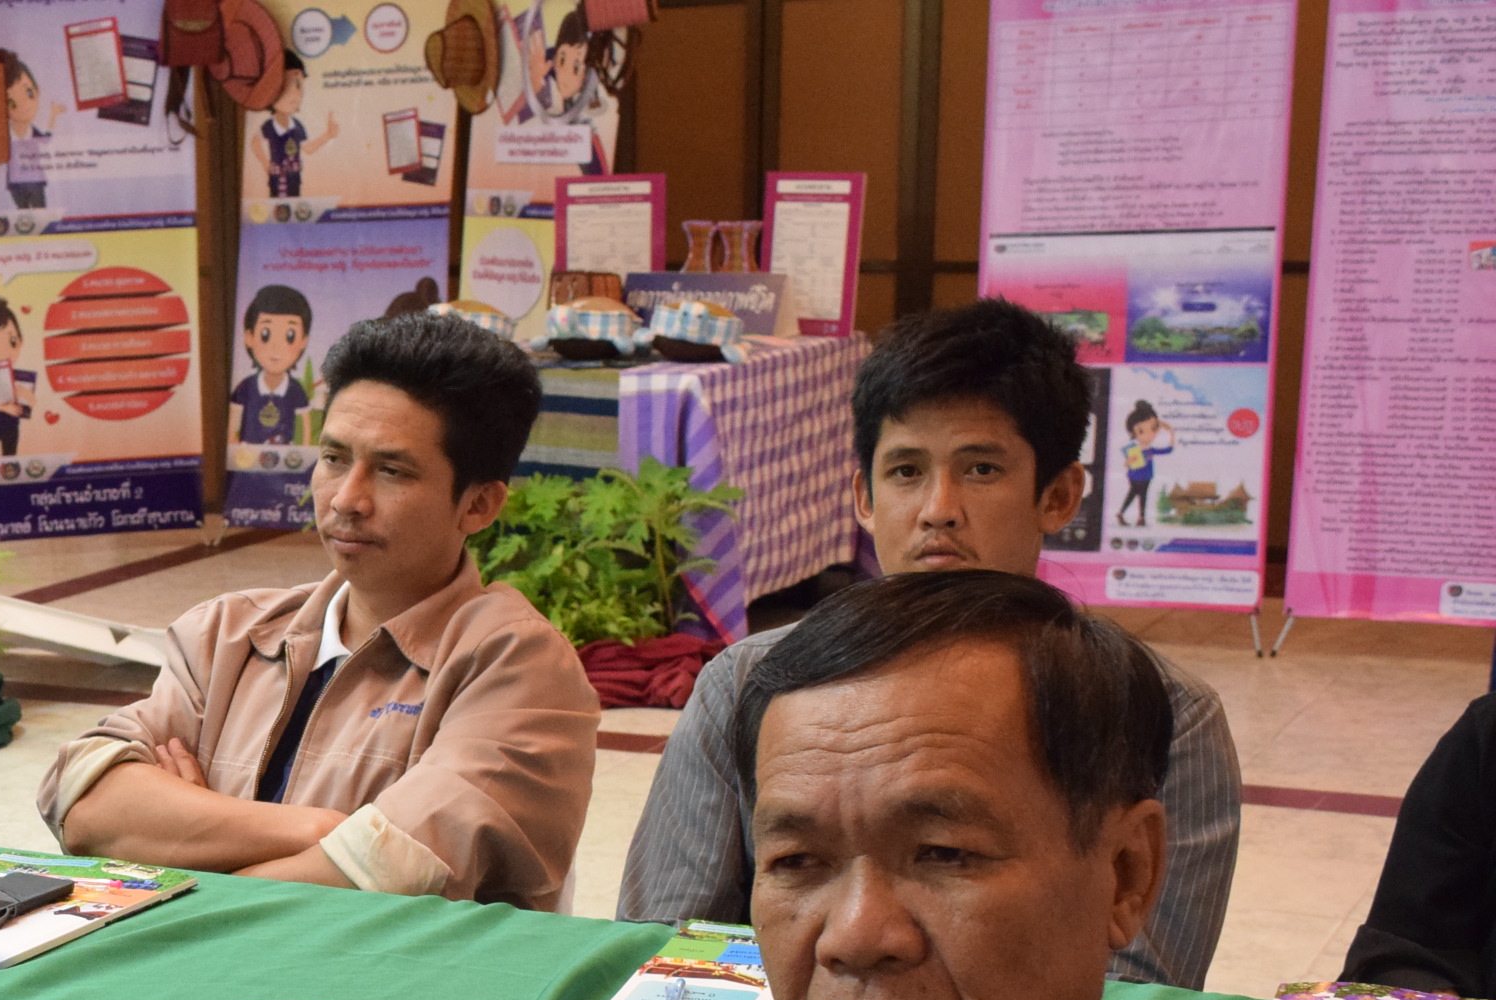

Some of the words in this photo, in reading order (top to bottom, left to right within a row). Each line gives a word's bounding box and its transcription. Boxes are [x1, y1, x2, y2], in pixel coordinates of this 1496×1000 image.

[30, 481, 132, 510] กลุ่มโซนอำเภอที่
